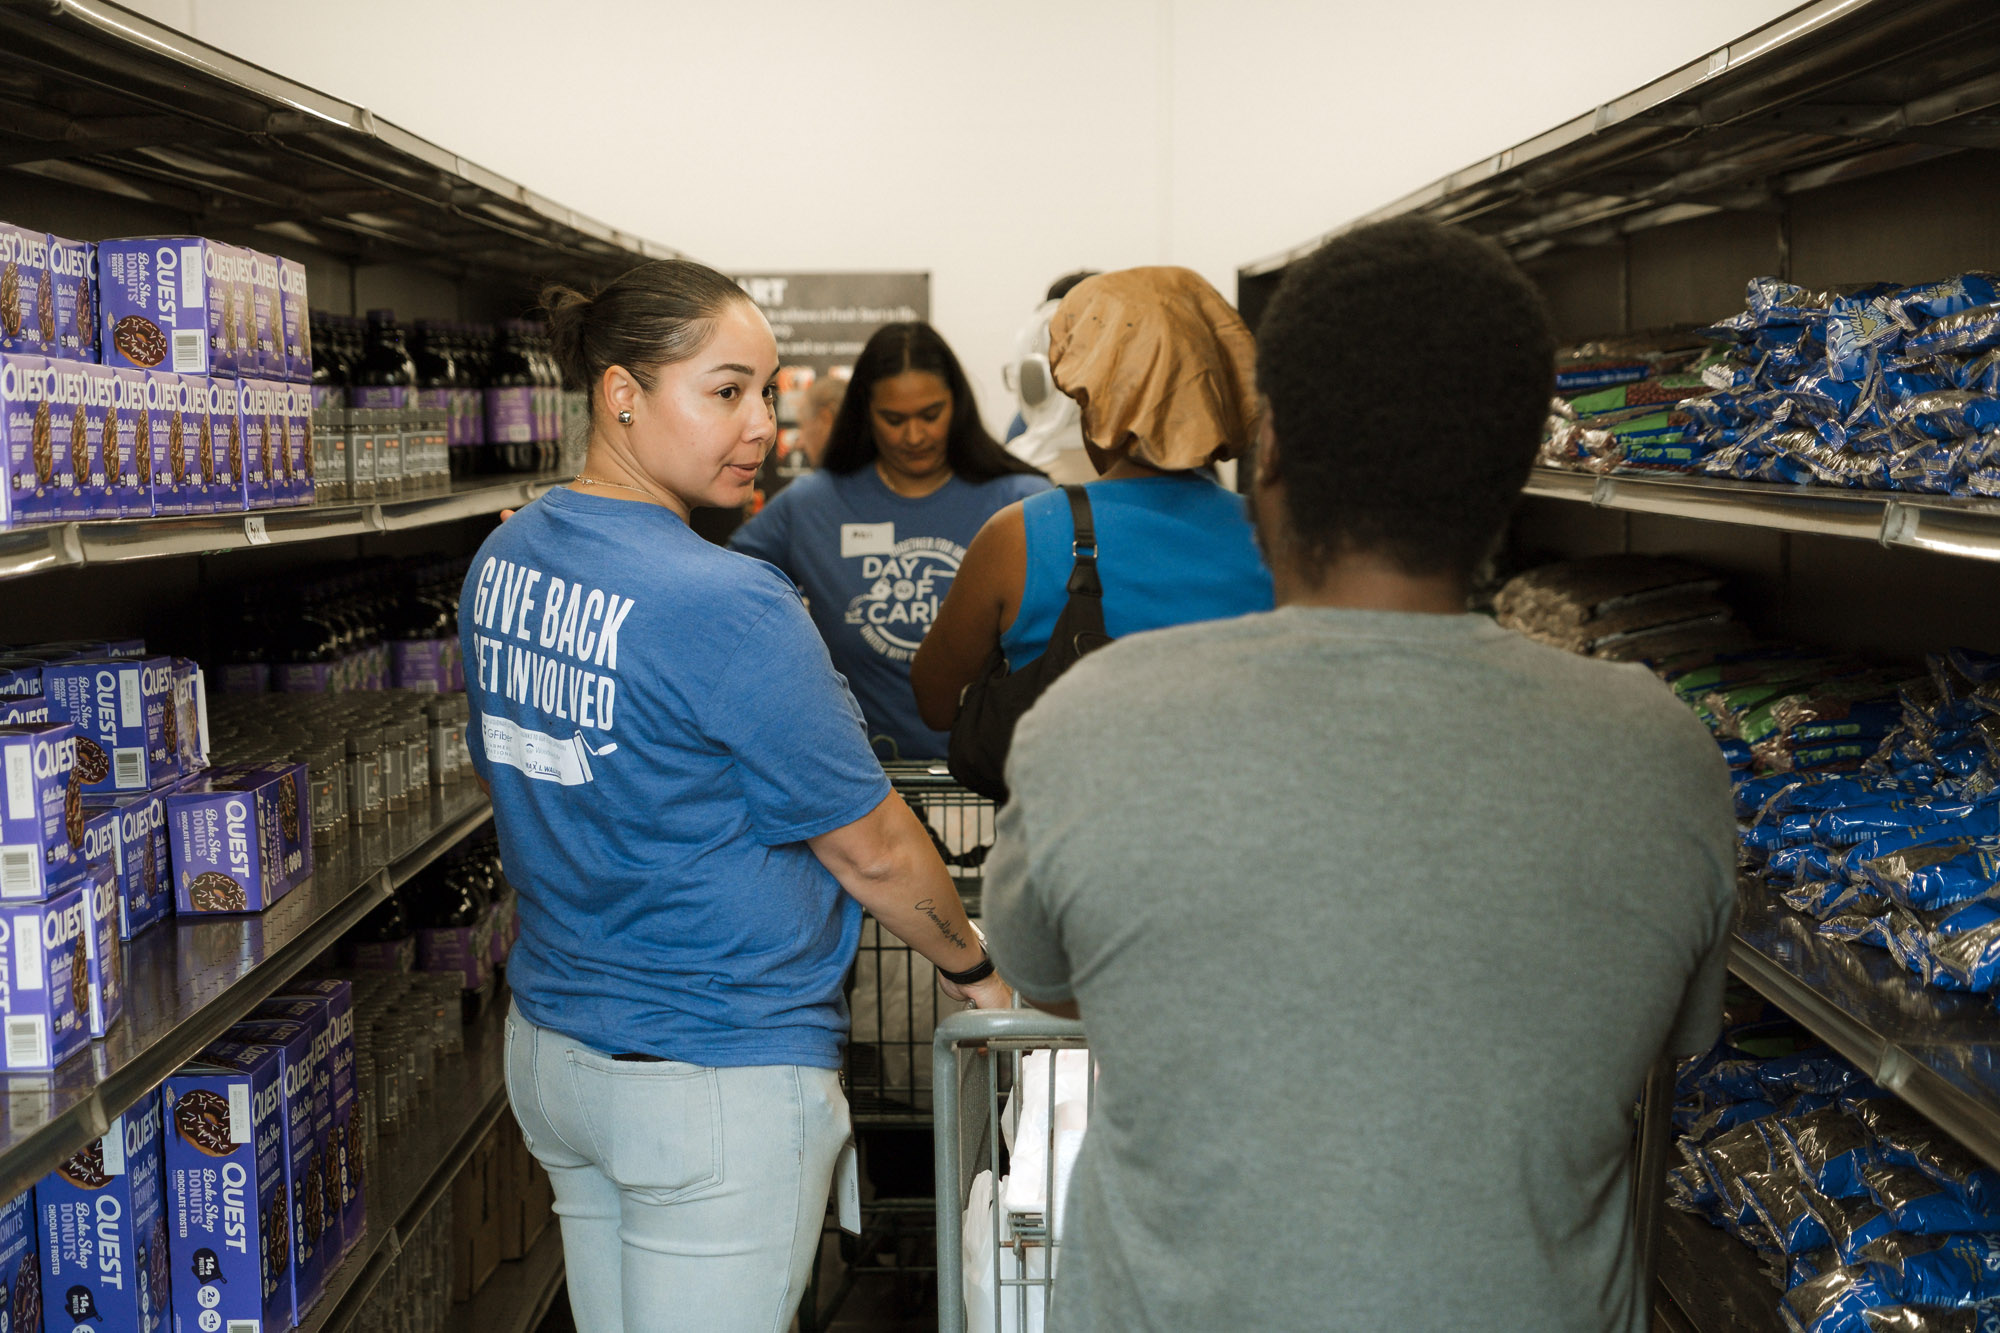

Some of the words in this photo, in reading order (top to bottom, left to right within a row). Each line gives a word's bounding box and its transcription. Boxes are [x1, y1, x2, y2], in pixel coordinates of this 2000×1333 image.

[15, 231, 49, 270] QUEST
[50, 242, 87, 279] QUEST
[137, 251, 150, 281] Bake
[117, 253, 125, 285] CHOCOLATE
[126, 253, 138, 301] DONUTS
[250, 255, 280, 290] QUEST
[280, 263, 308, 297] QUEST
[137, 282, 151, 309] Shop
[156, 246, 177, 328] QUEST
[1, 362, 48, 402] QUEST
[46, 366, 82, 405] QUEST
[112, 374, 148, 411] QUEST
[146, 377, 179, 412] QUEST
[178, 381, 209, 415] QUEST
[209, 384, 239, 416] QUEST
[241, 385, 271, 416] QUEST
[287, 388, 313, 418] QUEST
[862, 556, 920, 579] DAY
[893, 579, 935, 601] OF
[474, 556, 542, 641] GIVE
[539, 576, 635, 671] BACK
[59, 677, 67, 707] CHOCOLATE
[78, 676, 90, 704] Bake
[142, 666, 172, 697] QUEST
[506, 645, 616, 731] INVOLVED
[67, 677, 80, 723] DONUTS
[78, 704, 93, 730] Shop
[95, 670, 117, 747] QUEST
[487, 728, 513, 742] GFiber
[34, 736, 77, 780] QUEST
[84, 819, 116, 861] QUEST
[122, 807, 152, 844] QUEST
[180, 811, 190, 840] CHOCOLATE
[192, 809, 207, 857] DONUTS
[205, 808, 219, 838] Bake
[225, 800, 250, 878] QUEST
[206, 838, 221, 865] Shop
[93, 876, 115, 922] QUES
[43, 900, 85, 950] QUEST
[328, 1007, 354, 1049] QUEST
[312, 1028, 330, 1066] UEST
[285, 1050, 314, 1099] QUEST
[252, 1076, 283, 1128] QUEST
[125, 1108, 157, 1158] QUEST
[133, 1161, 148, 1188] Bake
[176, 1169, 186, 1208] CHOCOLATE
[203, 1168, 217, 1202] Bake
[134, 1175, 157, 1210] DONUTS
[188, 1169, 203, 1224] DONUTS
[222, 1162, 247, 1254] QUEST
[0, 1211, 24, 1243] ONUTS
[47, 1204, 58, 1244] CHOCOLATE
[60, 1203, 77, 1261] DONUTS
[75, 1202, 90, 1237] Bake
[178, 1209, 188, 1238] FROSTED
[202, 1202, 219, 1233] Shop
[74, 1238, 93, 1269] Shop
[95, 1194, 123, 1290] QUEST
[51, 1245, 60, 1276] FROSTED
[205, 1256, 215, 1276] 14g
[79, 1293, 90, 1314] 14g
[206, 1291, 215, 1303] 2g
